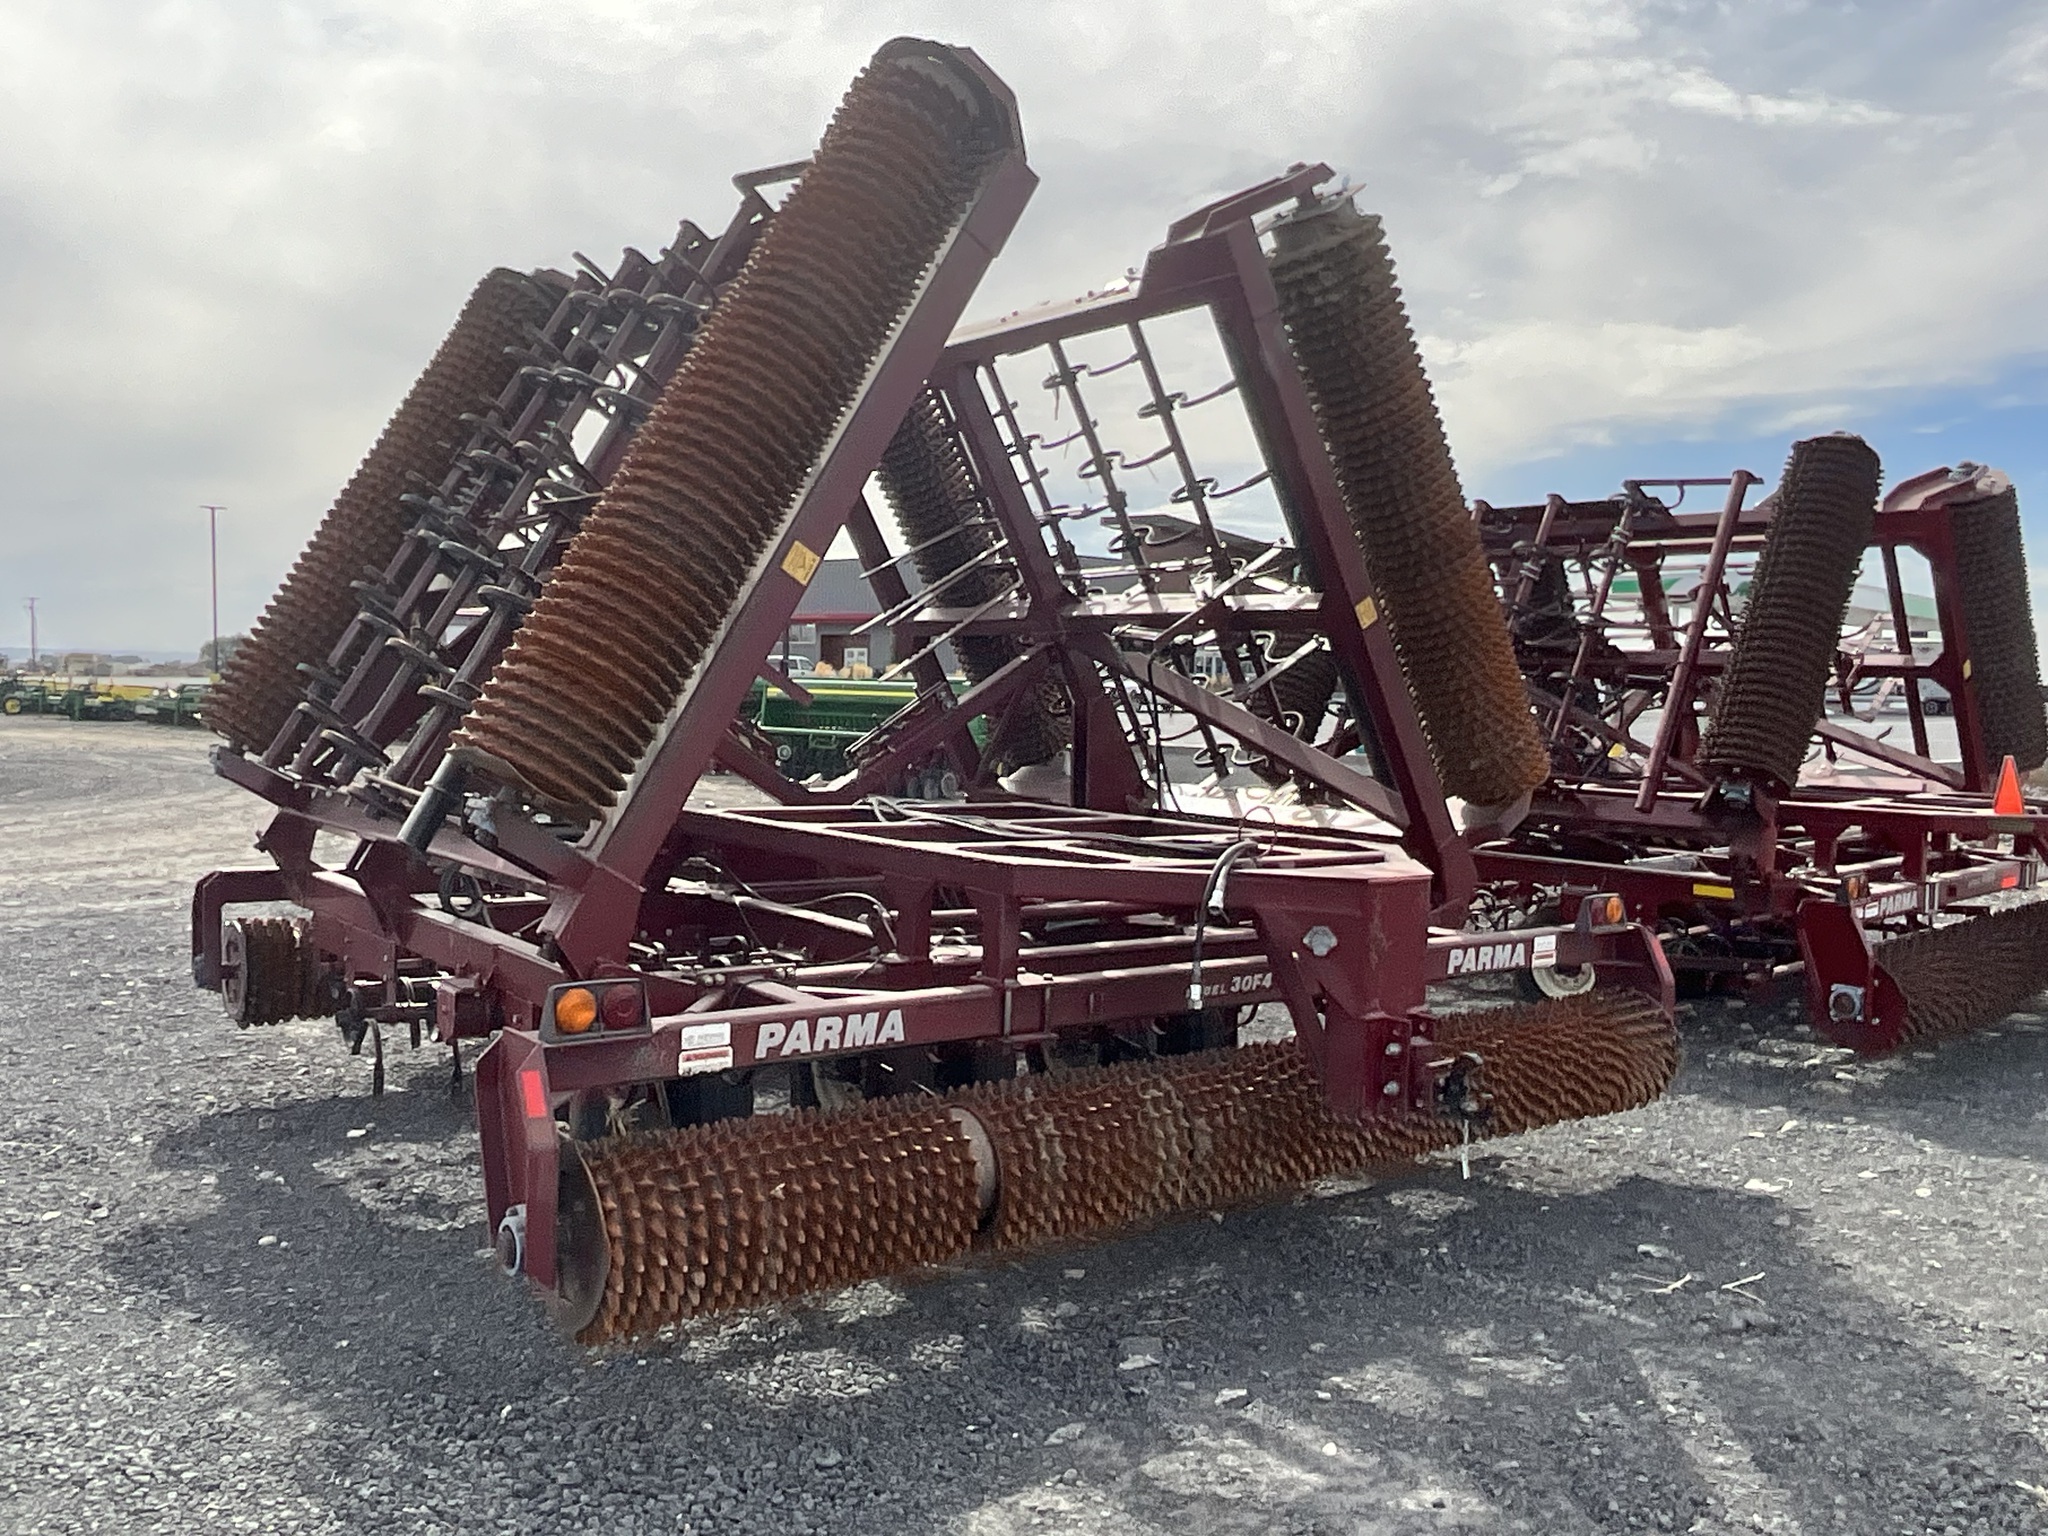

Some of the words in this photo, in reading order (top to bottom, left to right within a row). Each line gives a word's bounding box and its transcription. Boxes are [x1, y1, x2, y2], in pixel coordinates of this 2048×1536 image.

[1879, 890, 1918, 916] PARMA
[1447, 943, 1525, 974] PARMA
[1185, 984, 1226, 998] DEL
[1230, 972, 1273, 992] 30F4
[754, 1008, 905, 1059] PARMA
